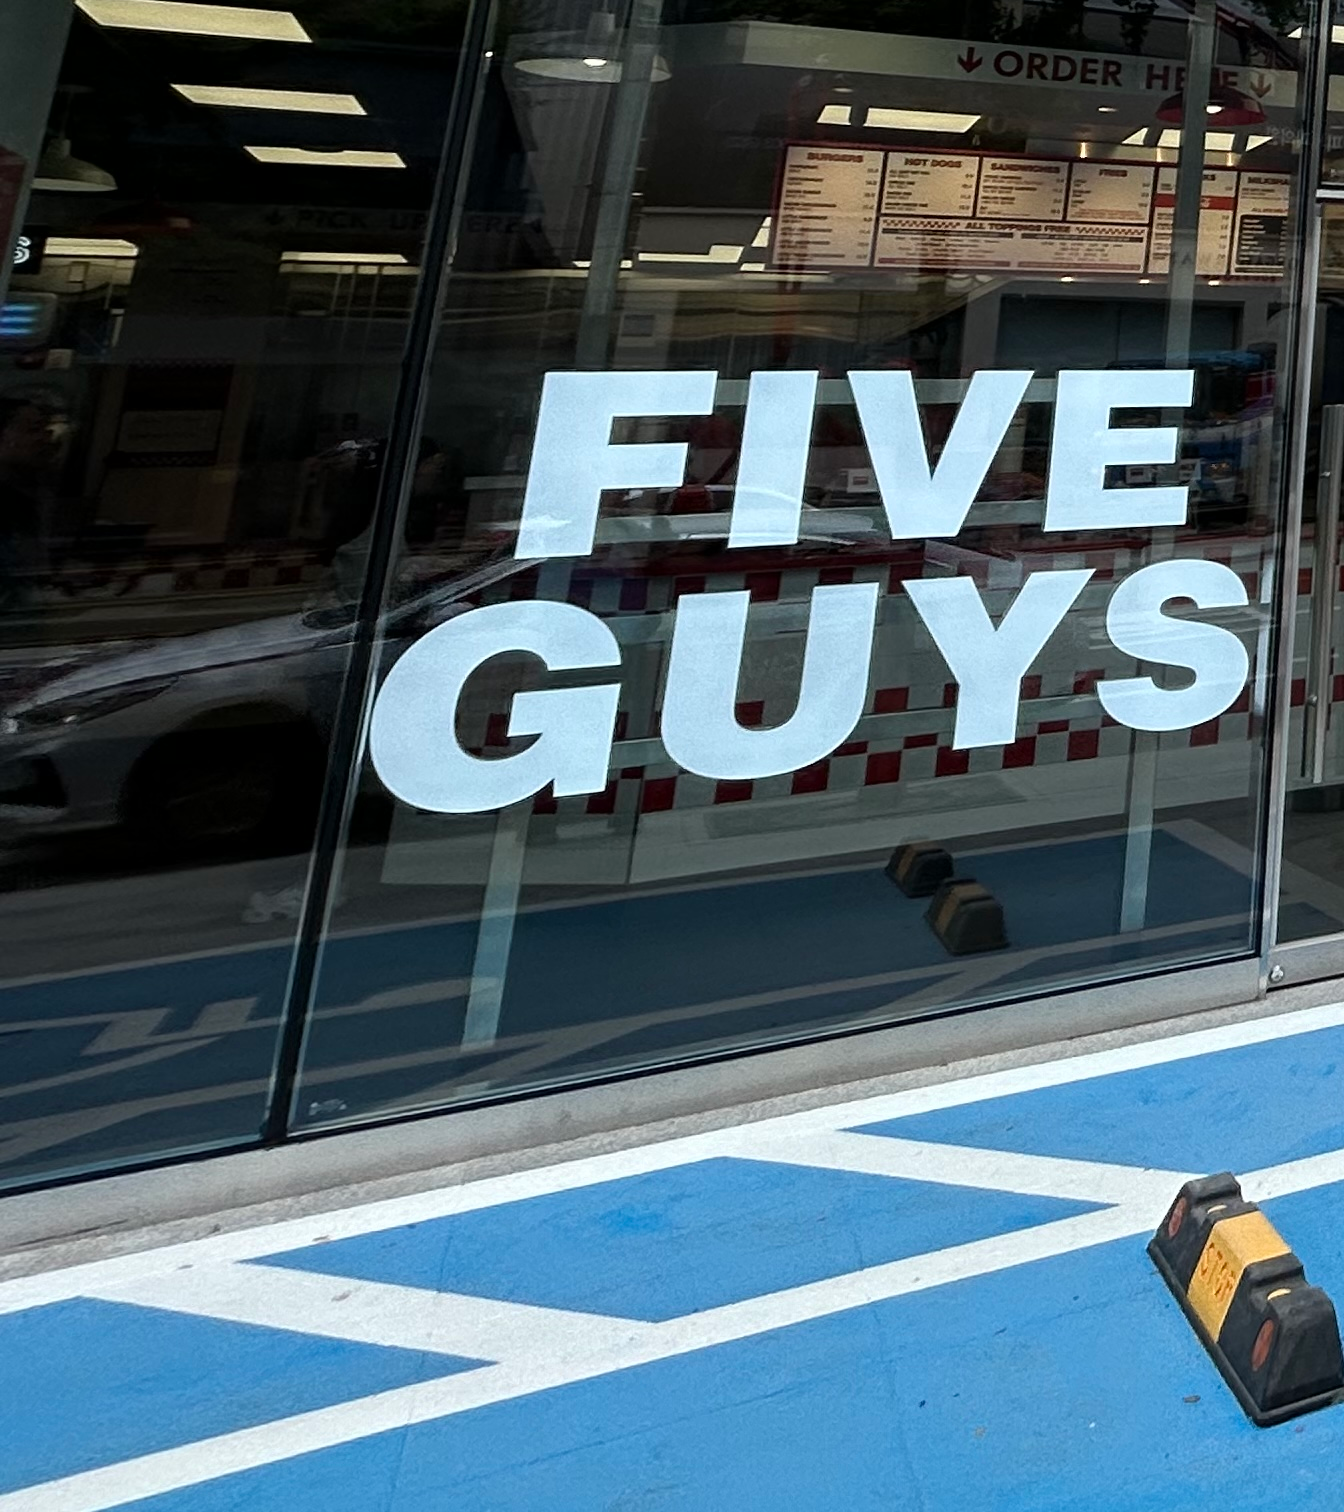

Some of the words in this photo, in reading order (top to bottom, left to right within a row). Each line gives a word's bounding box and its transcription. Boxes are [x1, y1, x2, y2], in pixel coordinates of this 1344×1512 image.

[993, 49, 1123, 87] ORDER
[1146, 63, 1239, 90] HEE
[807, 152, 865, 163] BURGERS
[990, 162, 1060, 173] SANDWICHES
[297, 210, 367, 229] PICK
[468, 214, 522, 233] ERE
[514, 370, 1195, 559] FIVE
[370, 558, 1250, 813] GUYS
